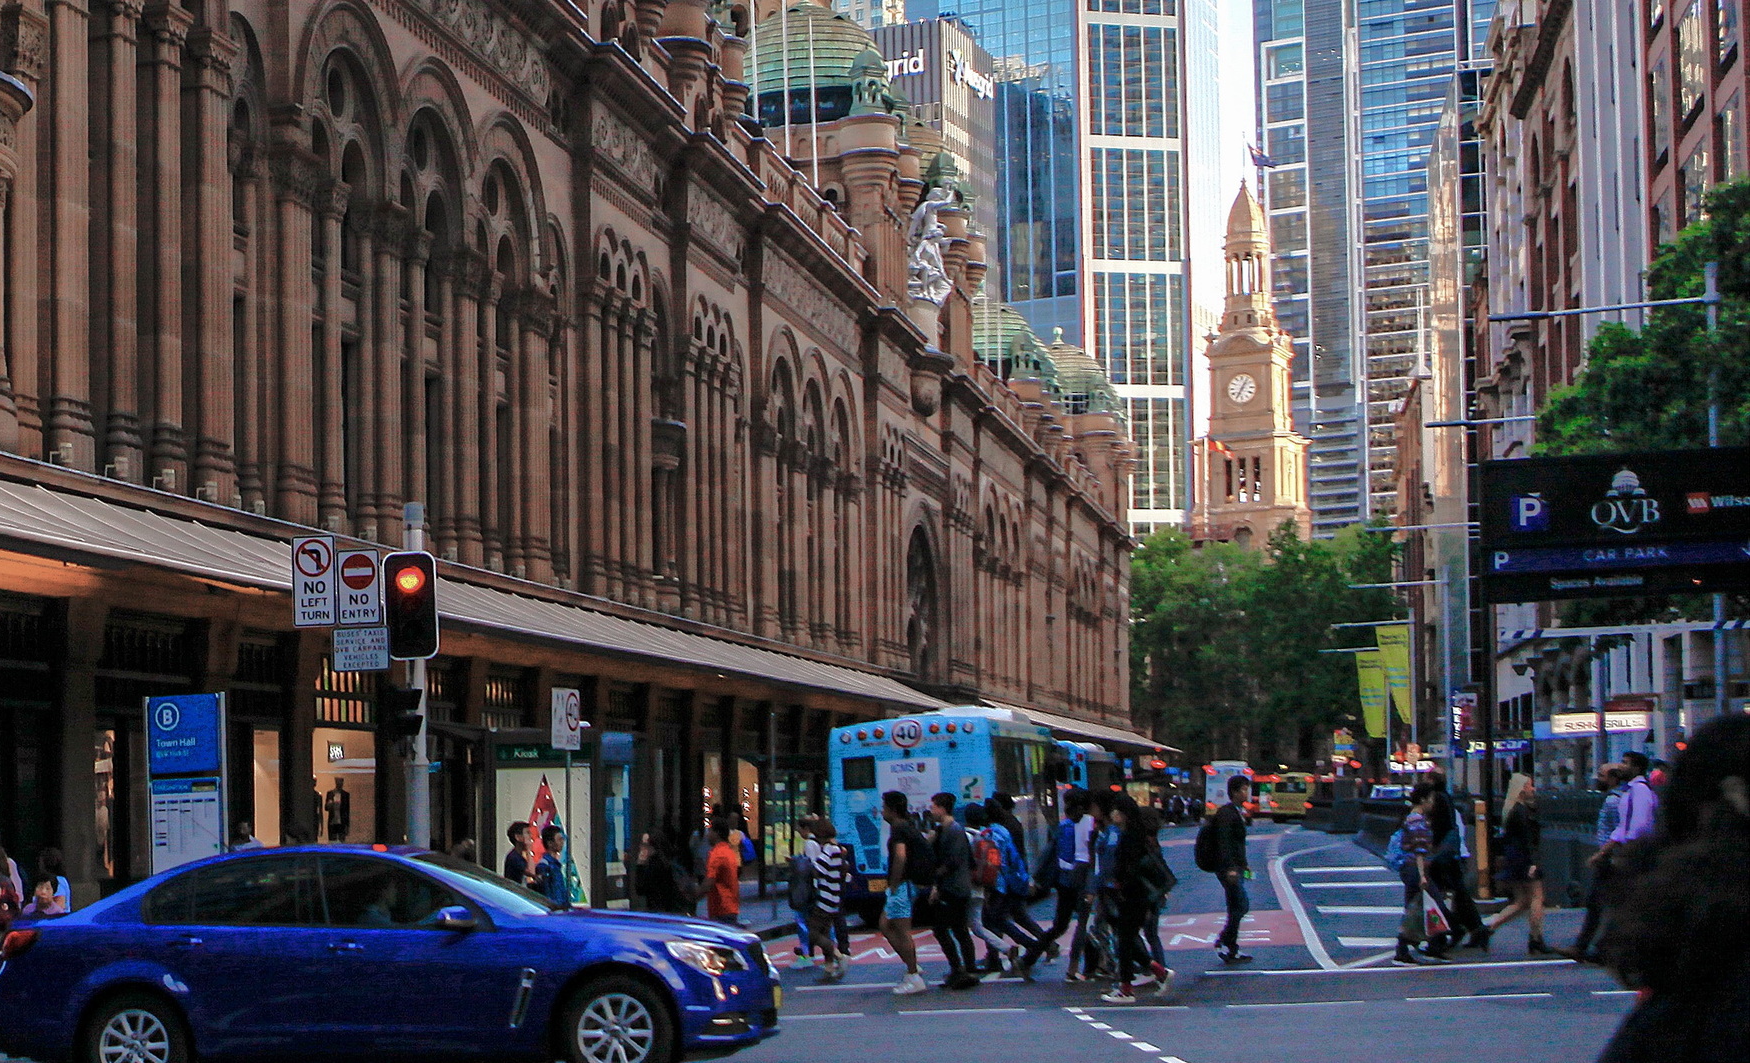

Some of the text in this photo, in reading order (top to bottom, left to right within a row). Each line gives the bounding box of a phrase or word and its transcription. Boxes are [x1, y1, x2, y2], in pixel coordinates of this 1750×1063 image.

[1518, 498, 1542, 526] P
[1591, 498, 1661, 534] QVB
[1494, 547, 1669, 570] P CAR PARK
[303, 580, 326, 594] NO
[301, 597, 327, 608] LEFT
[349, 593, 369, 605] NO
[301, 610, 330, 620] TURN
[342, 608, 377, 619] ENTRY
[162, 709, 174, 726] B
[896, 725, 918, 741] 40
[156, 737, 196, 748] Town Hall
